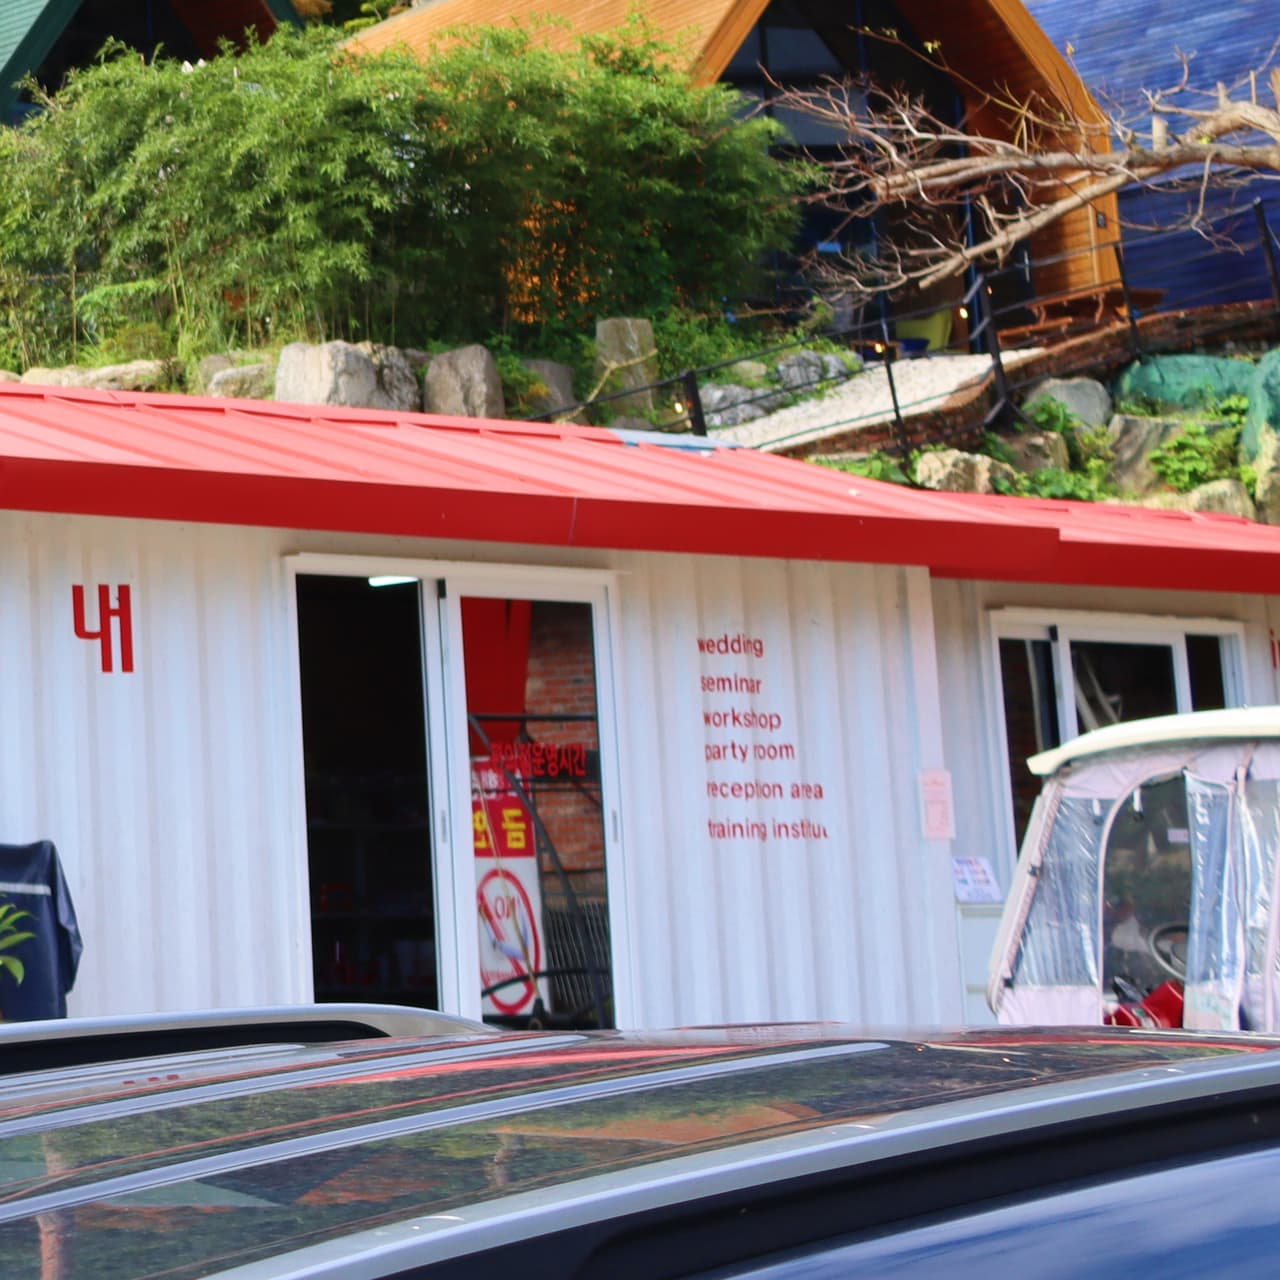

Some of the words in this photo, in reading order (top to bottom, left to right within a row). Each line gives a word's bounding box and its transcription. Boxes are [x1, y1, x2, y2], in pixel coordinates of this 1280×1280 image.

[697, 633, 764, 658] wedding
[700, 673, 762, 694] seminar
[703, 706, 782, 732] workshop
[704, 739, 748, 763] party
[754, 743, 795, 761] room
[791, 782, 824, 799] area
[708, 818, 767, 842] training
